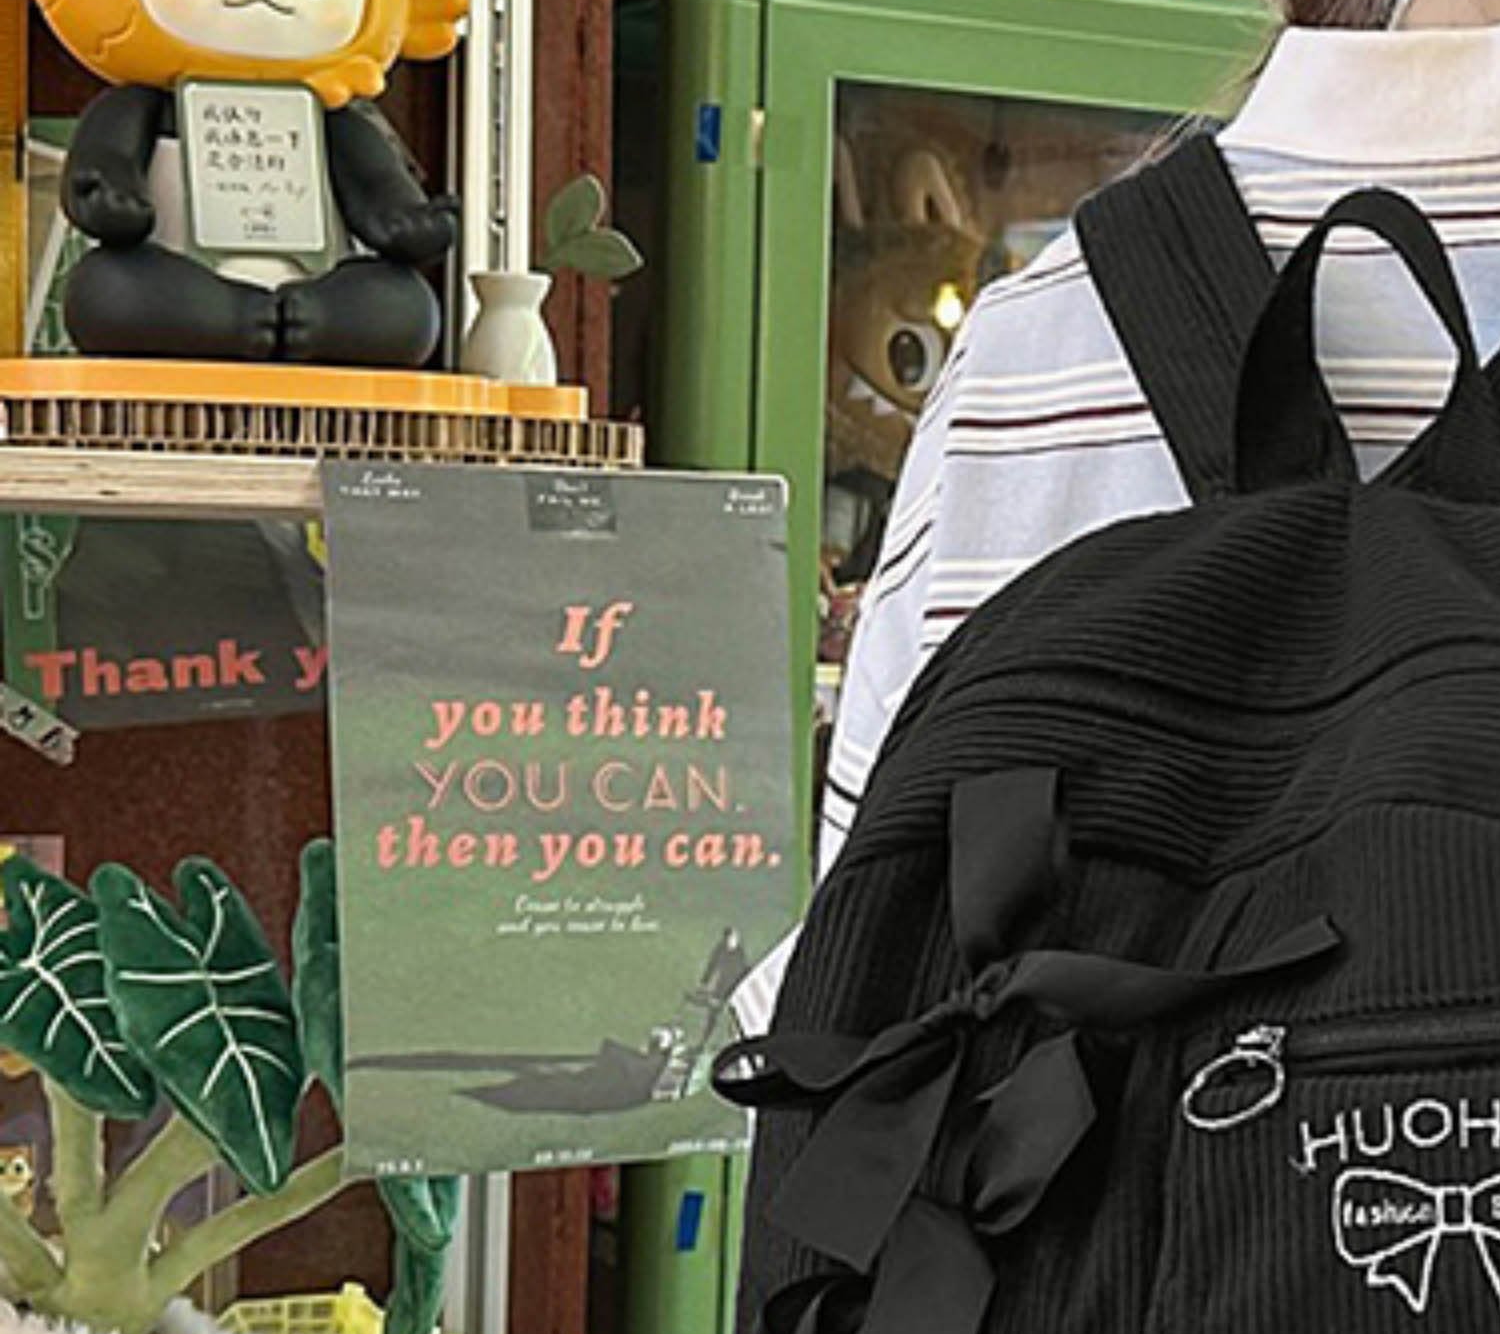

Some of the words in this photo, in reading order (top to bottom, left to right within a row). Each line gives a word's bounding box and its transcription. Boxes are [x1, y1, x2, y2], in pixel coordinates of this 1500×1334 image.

[555, 600, 634, 669] If
[25, 639, 266, 703] Thank
[425, 698, 546, 749] you
[566, 685, 729, 740] think
[413, 760, 568, 812] YOU
[376, 814, 519, 869] then
[531, 832, 647, 883] you
